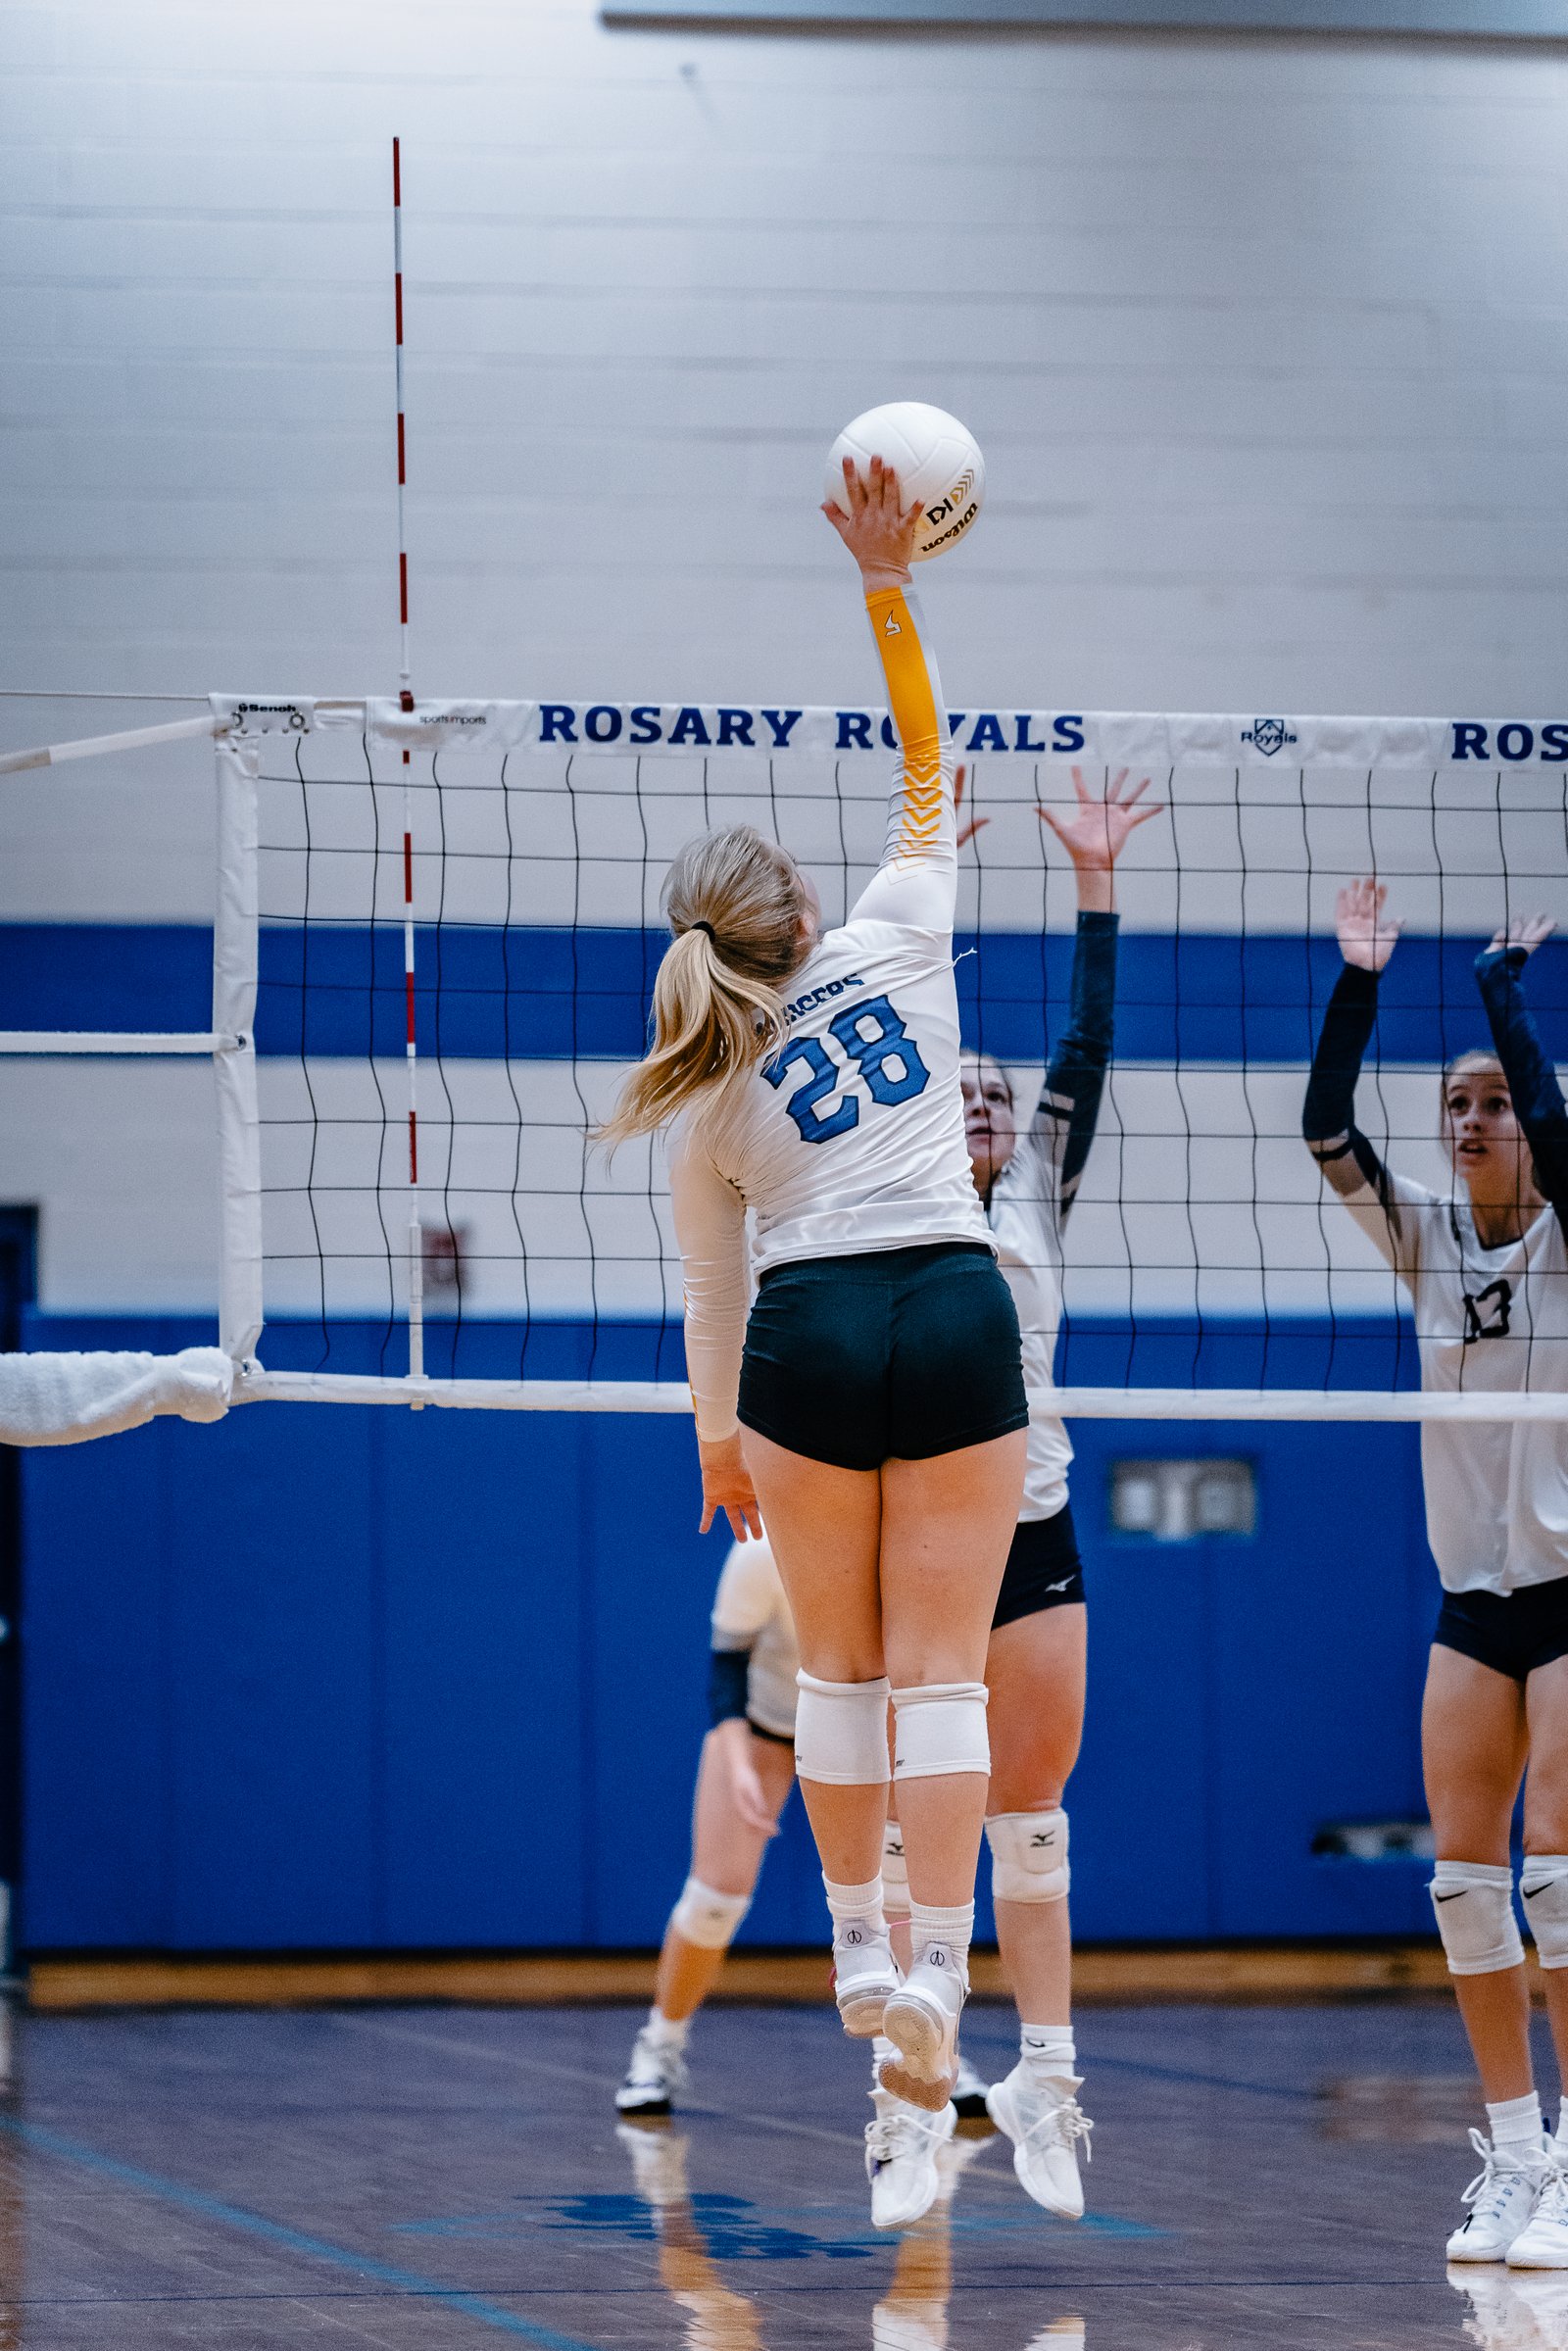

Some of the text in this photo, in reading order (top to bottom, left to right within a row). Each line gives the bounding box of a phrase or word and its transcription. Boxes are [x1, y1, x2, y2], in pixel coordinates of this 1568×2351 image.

[919, 503, 978, 552] Wilson
[539, 705, 803, 747] ROSARY
[1241, 732, 1298, 746] Royals
[760, 994, 931, 1145] 28
